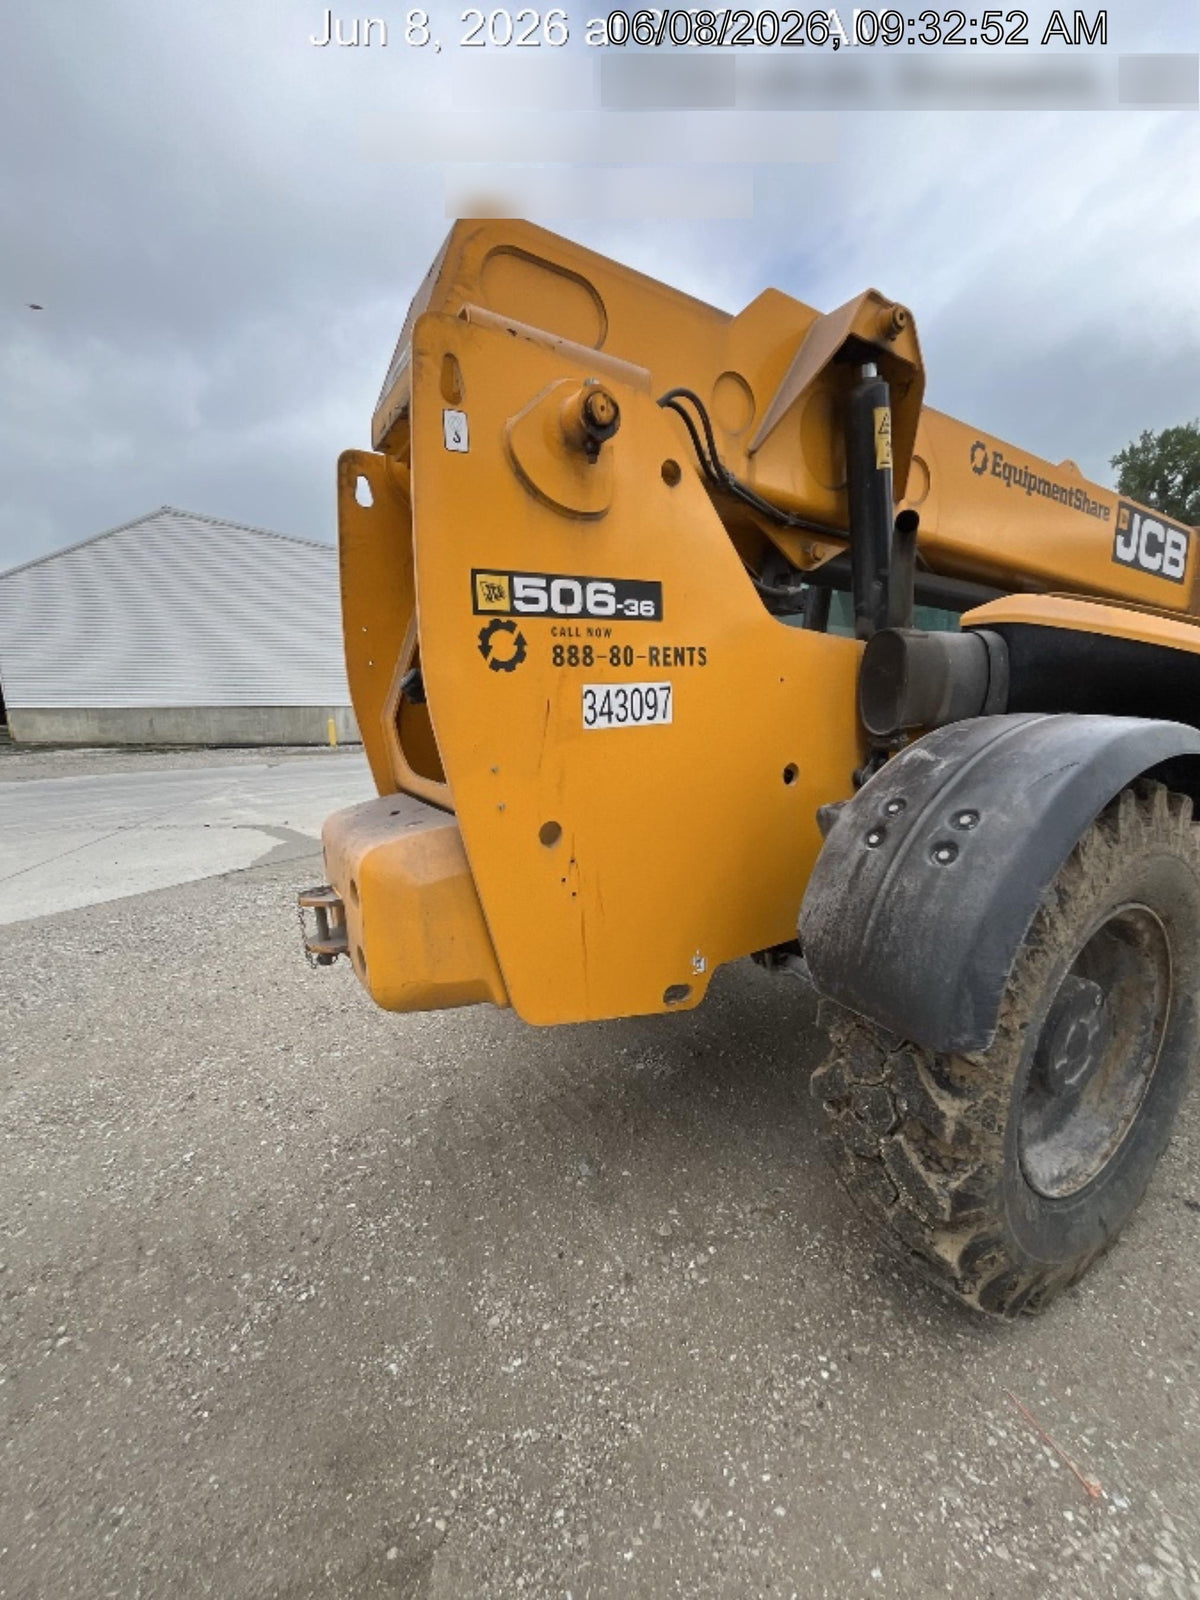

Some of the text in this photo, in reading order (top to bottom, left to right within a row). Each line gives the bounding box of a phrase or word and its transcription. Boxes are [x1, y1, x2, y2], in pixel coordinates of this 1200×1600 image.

[990, 450, 1111, 522] EquipmentShare
[1116, 512, 1187, 580] JCB
[513, 575, 656, 617] 506-36
[550, 626, 613, 639] CALL NOW
[552, 644, 708, 667] 888-80-RENTS
[583, 685, 671, 726] 343097
